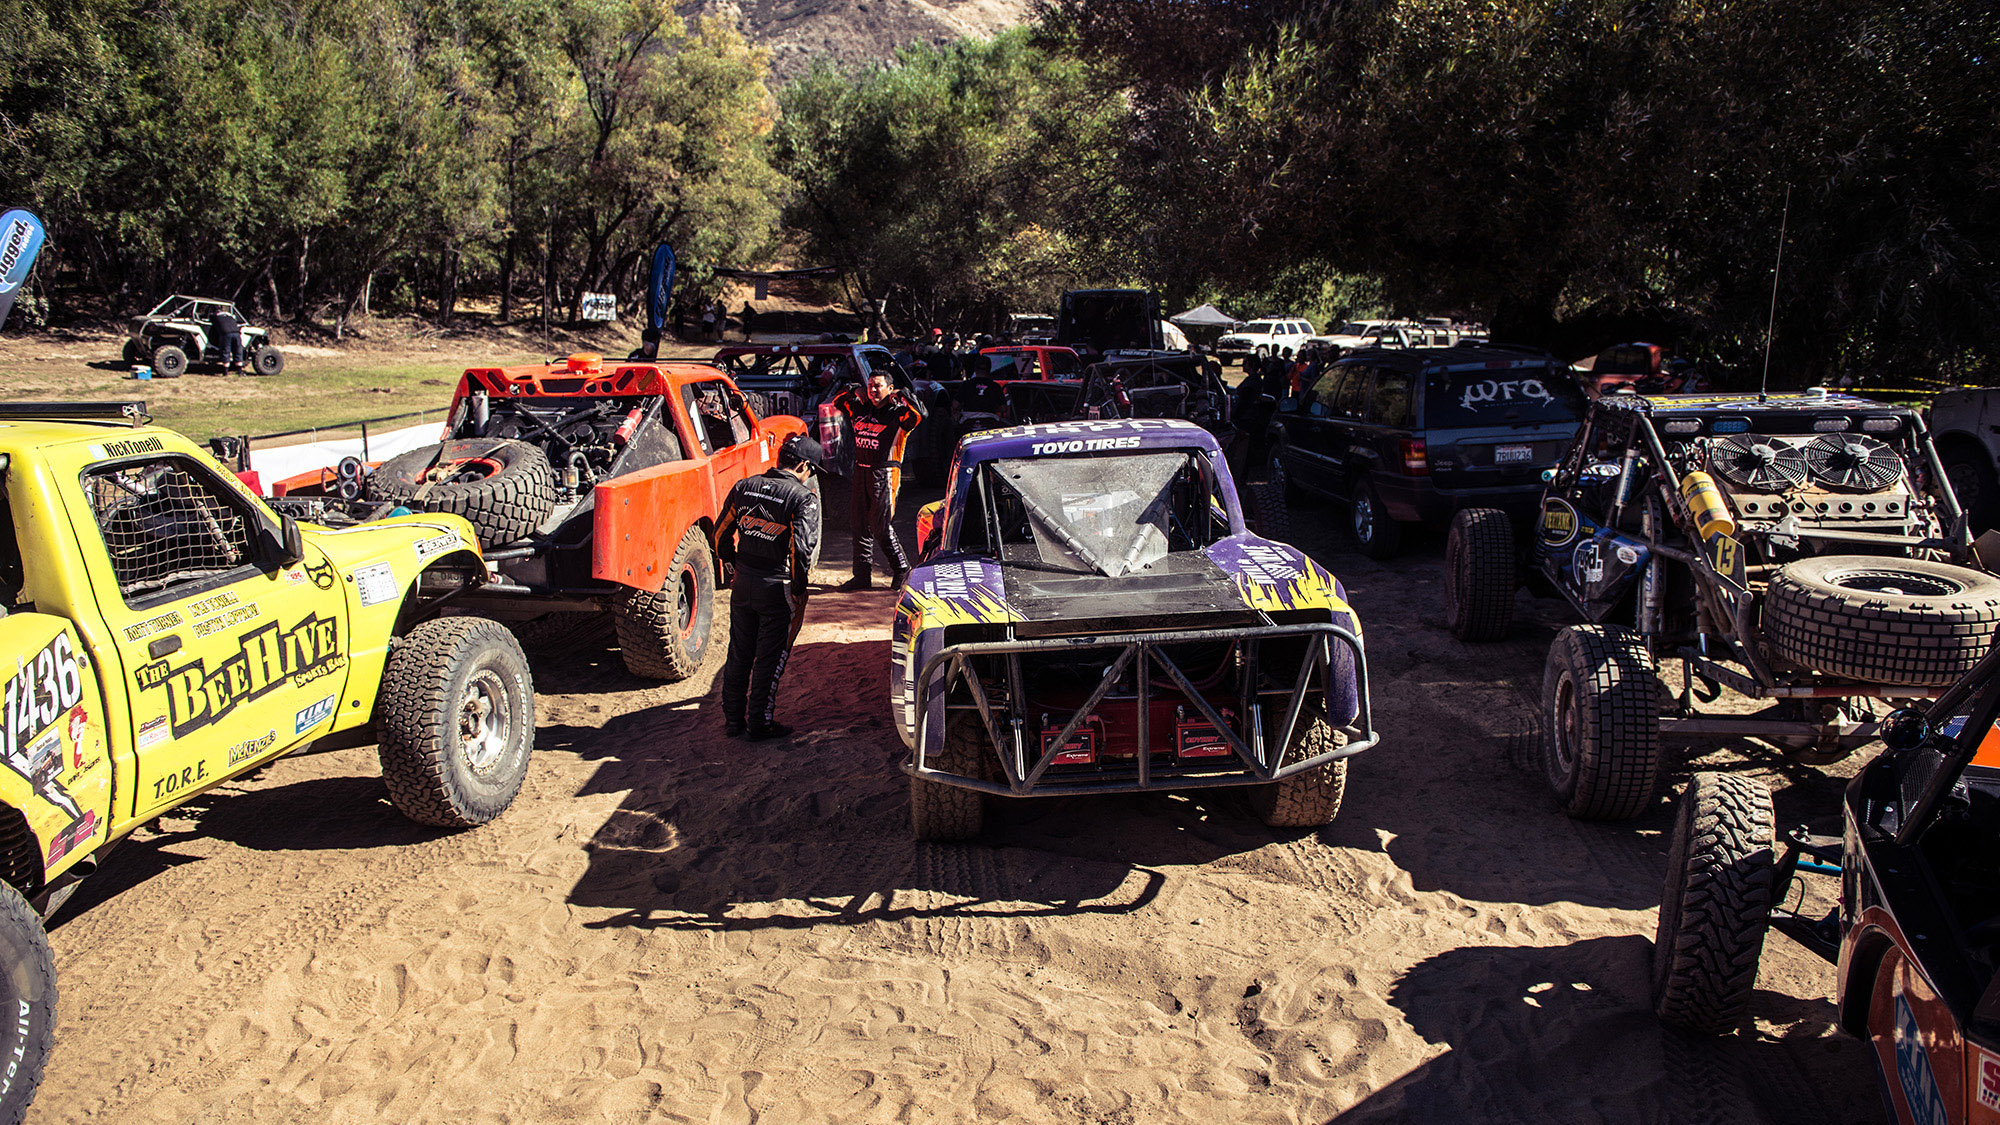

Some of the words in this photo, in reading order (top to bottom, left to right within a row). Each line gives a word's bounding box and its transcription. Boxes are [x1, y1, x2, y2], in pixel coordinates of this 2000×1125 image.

[0, 218, 29, 284] ugged.
[1020, 358, 1031, 373] 7
[1462, 379, 1551, 405] WFO
[102, 436, 163, 458] NickTonelli
[1032, 440, 1083, 455] TOYO
[1085, 437, 1142, 450] TIRES
[740, 515, 788, 536] RPM
[744, 529, 778, 541] offroad
[1716, 537, 1736, 575] 13
[123, 621, 151, 643] MATT
[149, 611, 184, 633] TURNER
[136, 663, 170, 688] THE
[295, 664, 328, 687] SPORTS
[5, 632, 81, 757] 1436
[1185, 735, 1220, 744] ODYSSEY
[153, 760, 209, 799] T.O.R.E.
